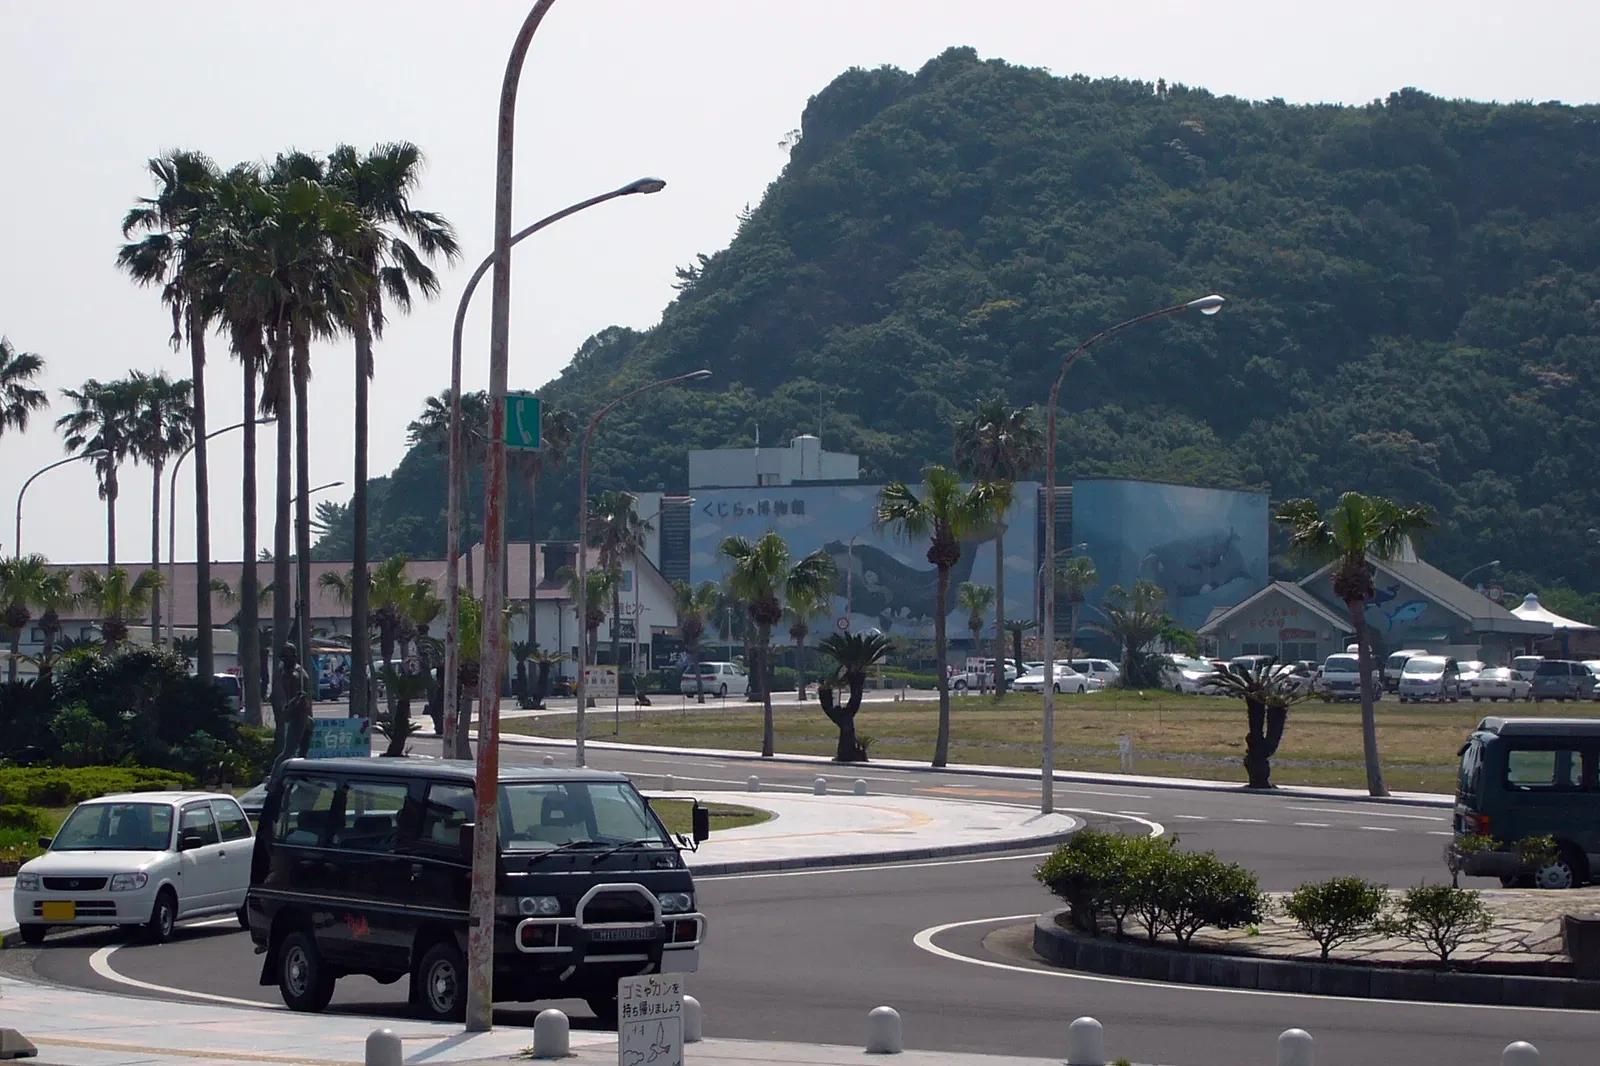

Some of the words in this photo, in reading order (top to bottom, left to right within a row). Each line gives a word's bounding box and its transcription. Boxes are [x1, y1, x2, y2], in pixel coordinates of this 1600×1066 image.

[600, 930, 649, 940] MITSUBISHI
[623, 981, 680, 1000] ゴミやカンを
[622, 1000, 681, 1019] 持ち帰りましょう
